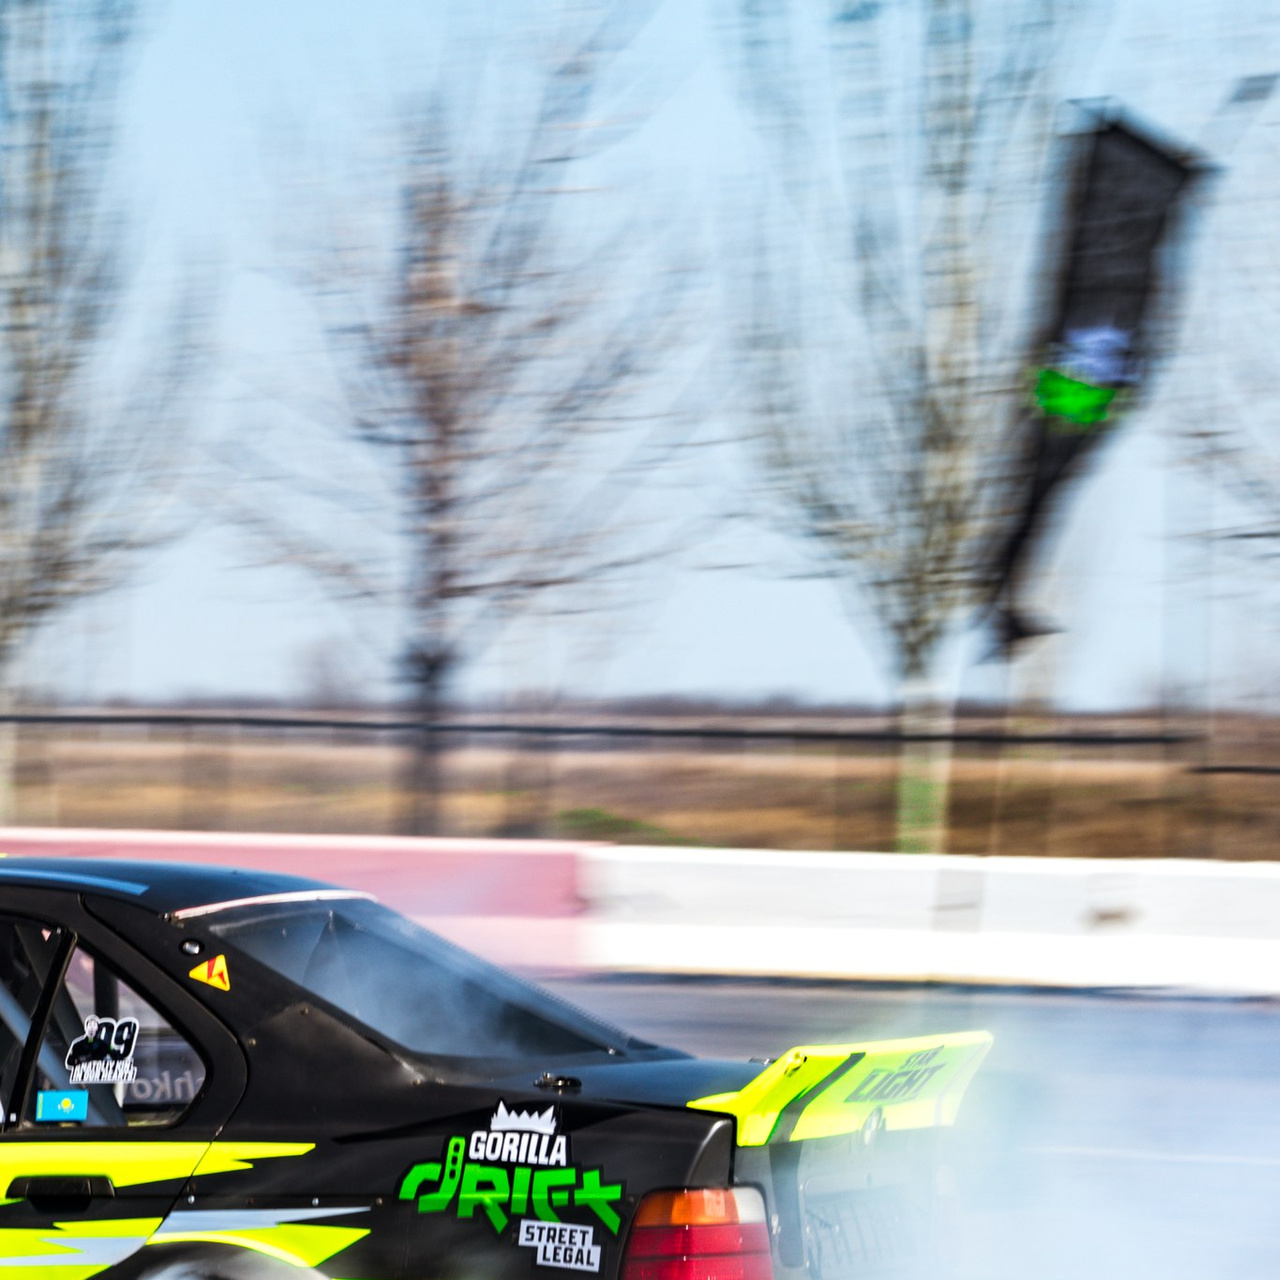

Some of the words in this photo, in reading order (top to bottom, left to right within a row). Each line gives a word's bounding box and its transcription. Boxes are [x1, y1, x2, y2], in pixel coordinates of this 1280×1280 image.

[469, 1131, 567, 1166] GORILLA
[525, 1225, 589, 1247] STREET
[541, 1246, 595, 1267] LEGAL
